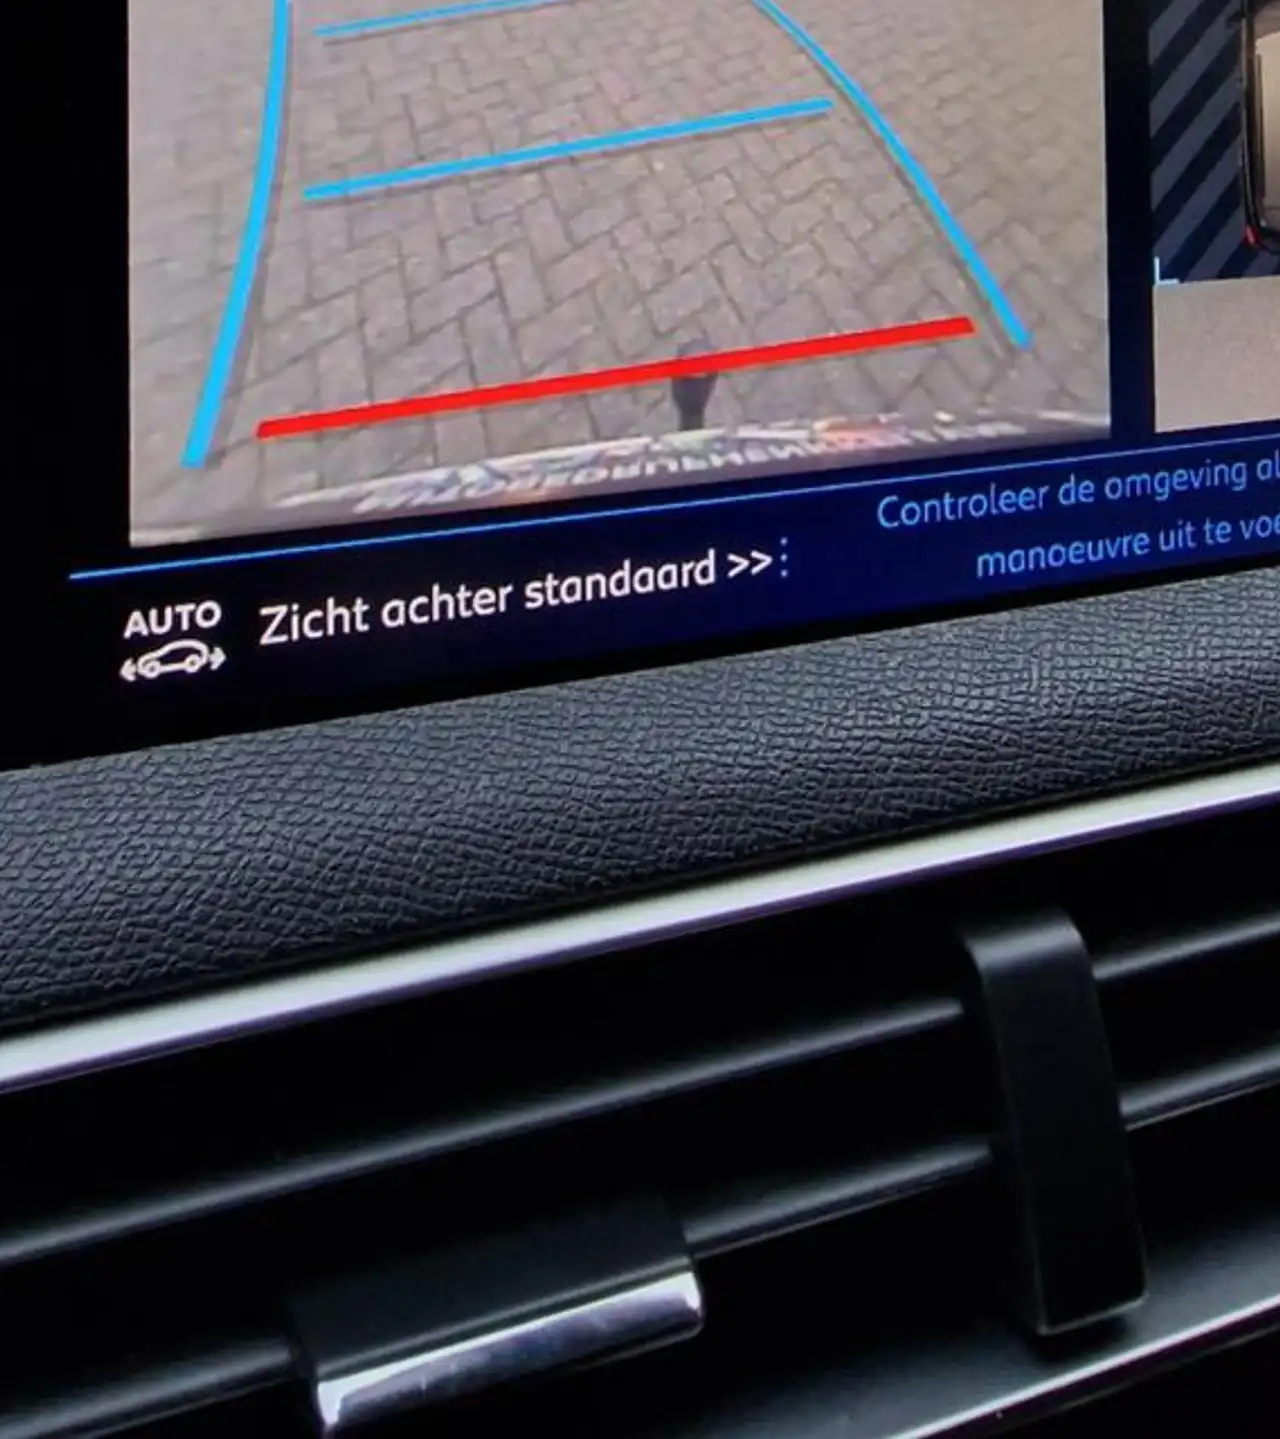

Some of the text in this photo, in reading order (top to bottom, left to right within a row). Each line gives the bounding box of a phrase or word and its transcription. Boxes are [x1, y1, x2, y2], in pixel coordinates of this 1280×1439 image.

[877, 481, 1049, 528] Controleer
[1058, 473, 1095, 506] de
[1104, 458, 1247, 501] omgeving
[976, 531, 1150, 578] manoeuvre
[1158, 520, 1197, 552] uit
[1204, 516, 1232, 545] te
[123, 600, 222, 638] AUTO
[258, 597, 370, 645] Zicht
[380, 582, 513, 628] achter
[524, 549, 716, 609] standaard
